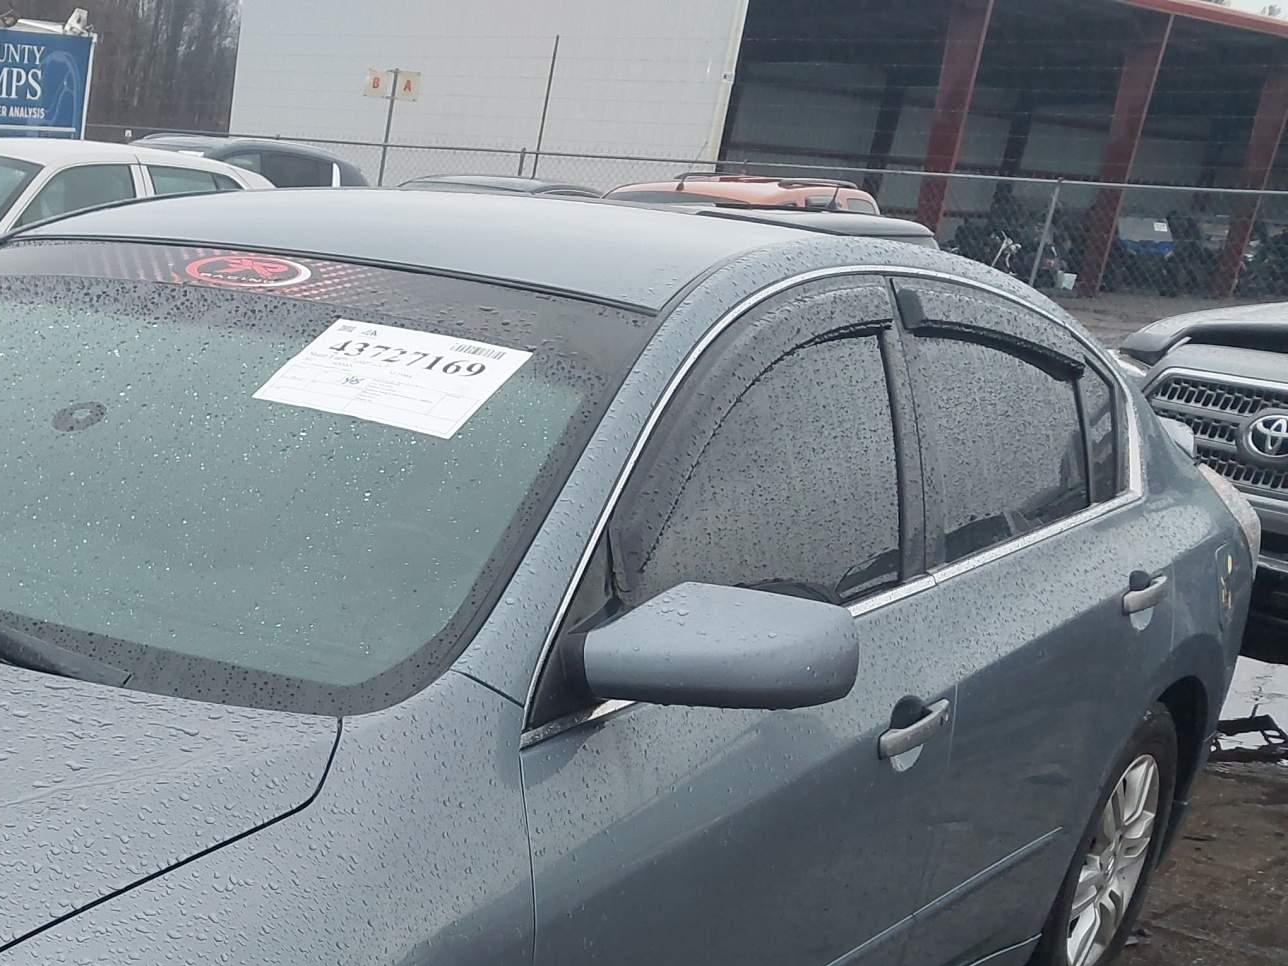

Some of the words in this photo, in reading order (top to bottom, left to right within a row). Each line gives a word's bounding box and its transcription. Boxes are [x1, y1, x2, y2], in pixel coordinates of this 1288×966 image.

[372, 76, 380, 89] B
[403, 79, 412, 92] A
[9, 105, 46, 119] ANALYSIS
[328, 339, 486, 377] 43727169
